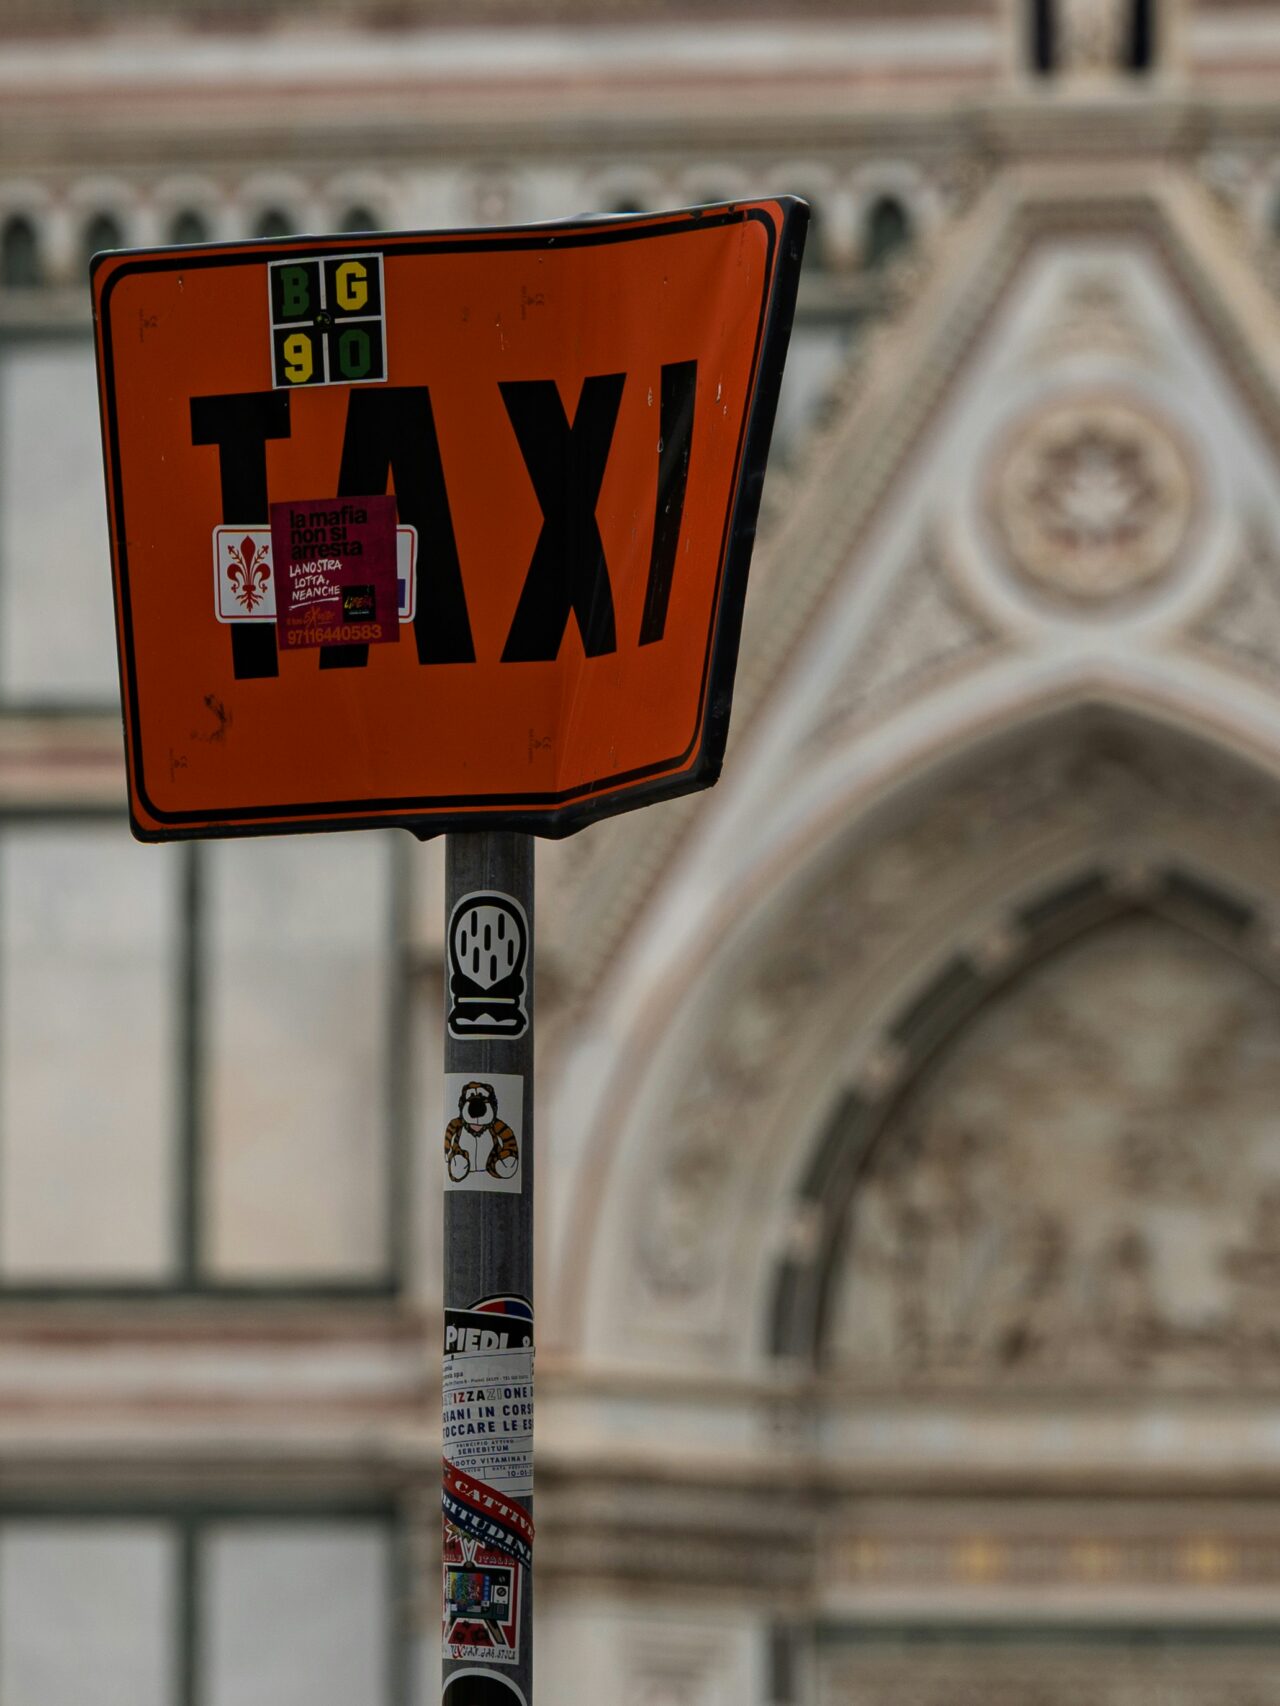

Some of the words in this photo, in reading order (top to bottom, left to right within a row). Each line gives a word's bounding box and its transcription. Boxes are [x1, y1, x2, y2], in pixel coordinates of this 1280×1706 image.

[189, 358, 699, 680] TAXI
[289, 509, 305, 528] la
[309, 505, 368, 527] mafia
[290, 528, 326, 545] non
[330, 526, 347, 541] si
[291, 541, 362, 560] arresta
[289, 564, 301, 577] LA
[301, 559, 343, 575] NOSTRA
[294, 574, 331, 589] LOTTA,
[292, 585, 341, 601] NEANCHE
[287, 623, 383, 646] 97116440583
[445, 1325, 509, 1352] PIEDI
[478, 1406, 495, 1418] IN
[503, 1420, 518, 1432] LE
[480, 1456, 522, 1464] VITAMINA
